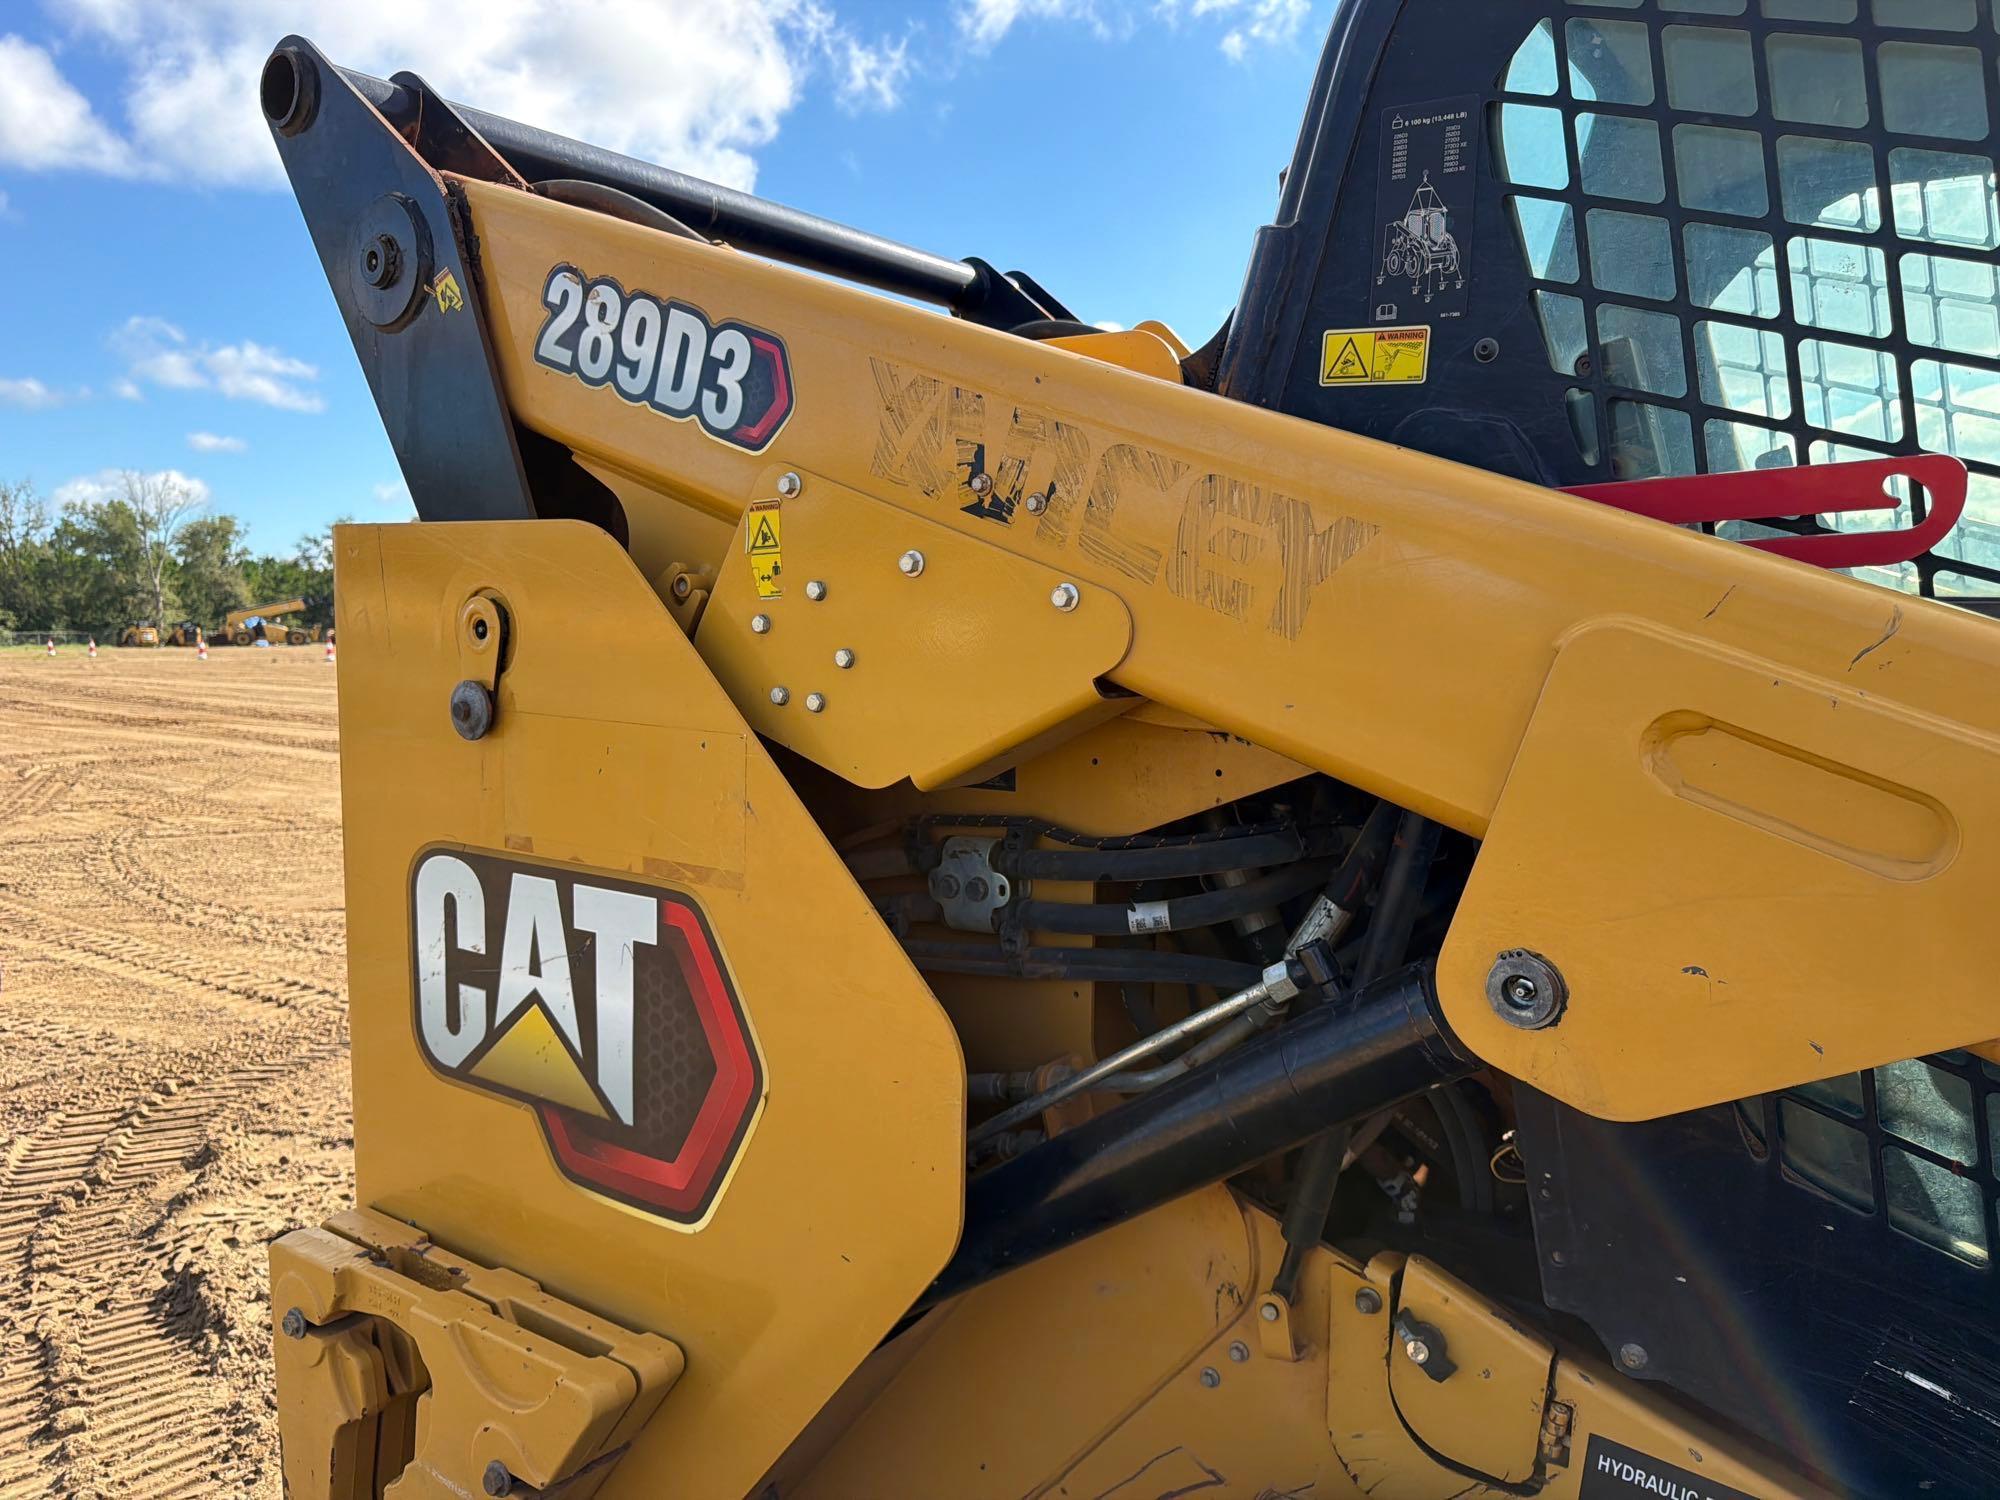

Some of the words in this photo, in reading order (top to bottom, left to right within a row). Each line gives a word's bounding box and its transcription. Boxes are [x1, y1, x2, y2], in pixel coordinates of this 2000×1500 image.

[1411, 118, 1422, 126] 100
[1455, 111, 1468, 119] LB)
[1387, 331, 1424, 340] WARNING
[538, 272, 752, 430] 289D3
[755, 503, 779, 511] WARNING
[416, 855, 658, 1127] CAT
[1597, 1454, 1699, 1500] HYDRAULIC
